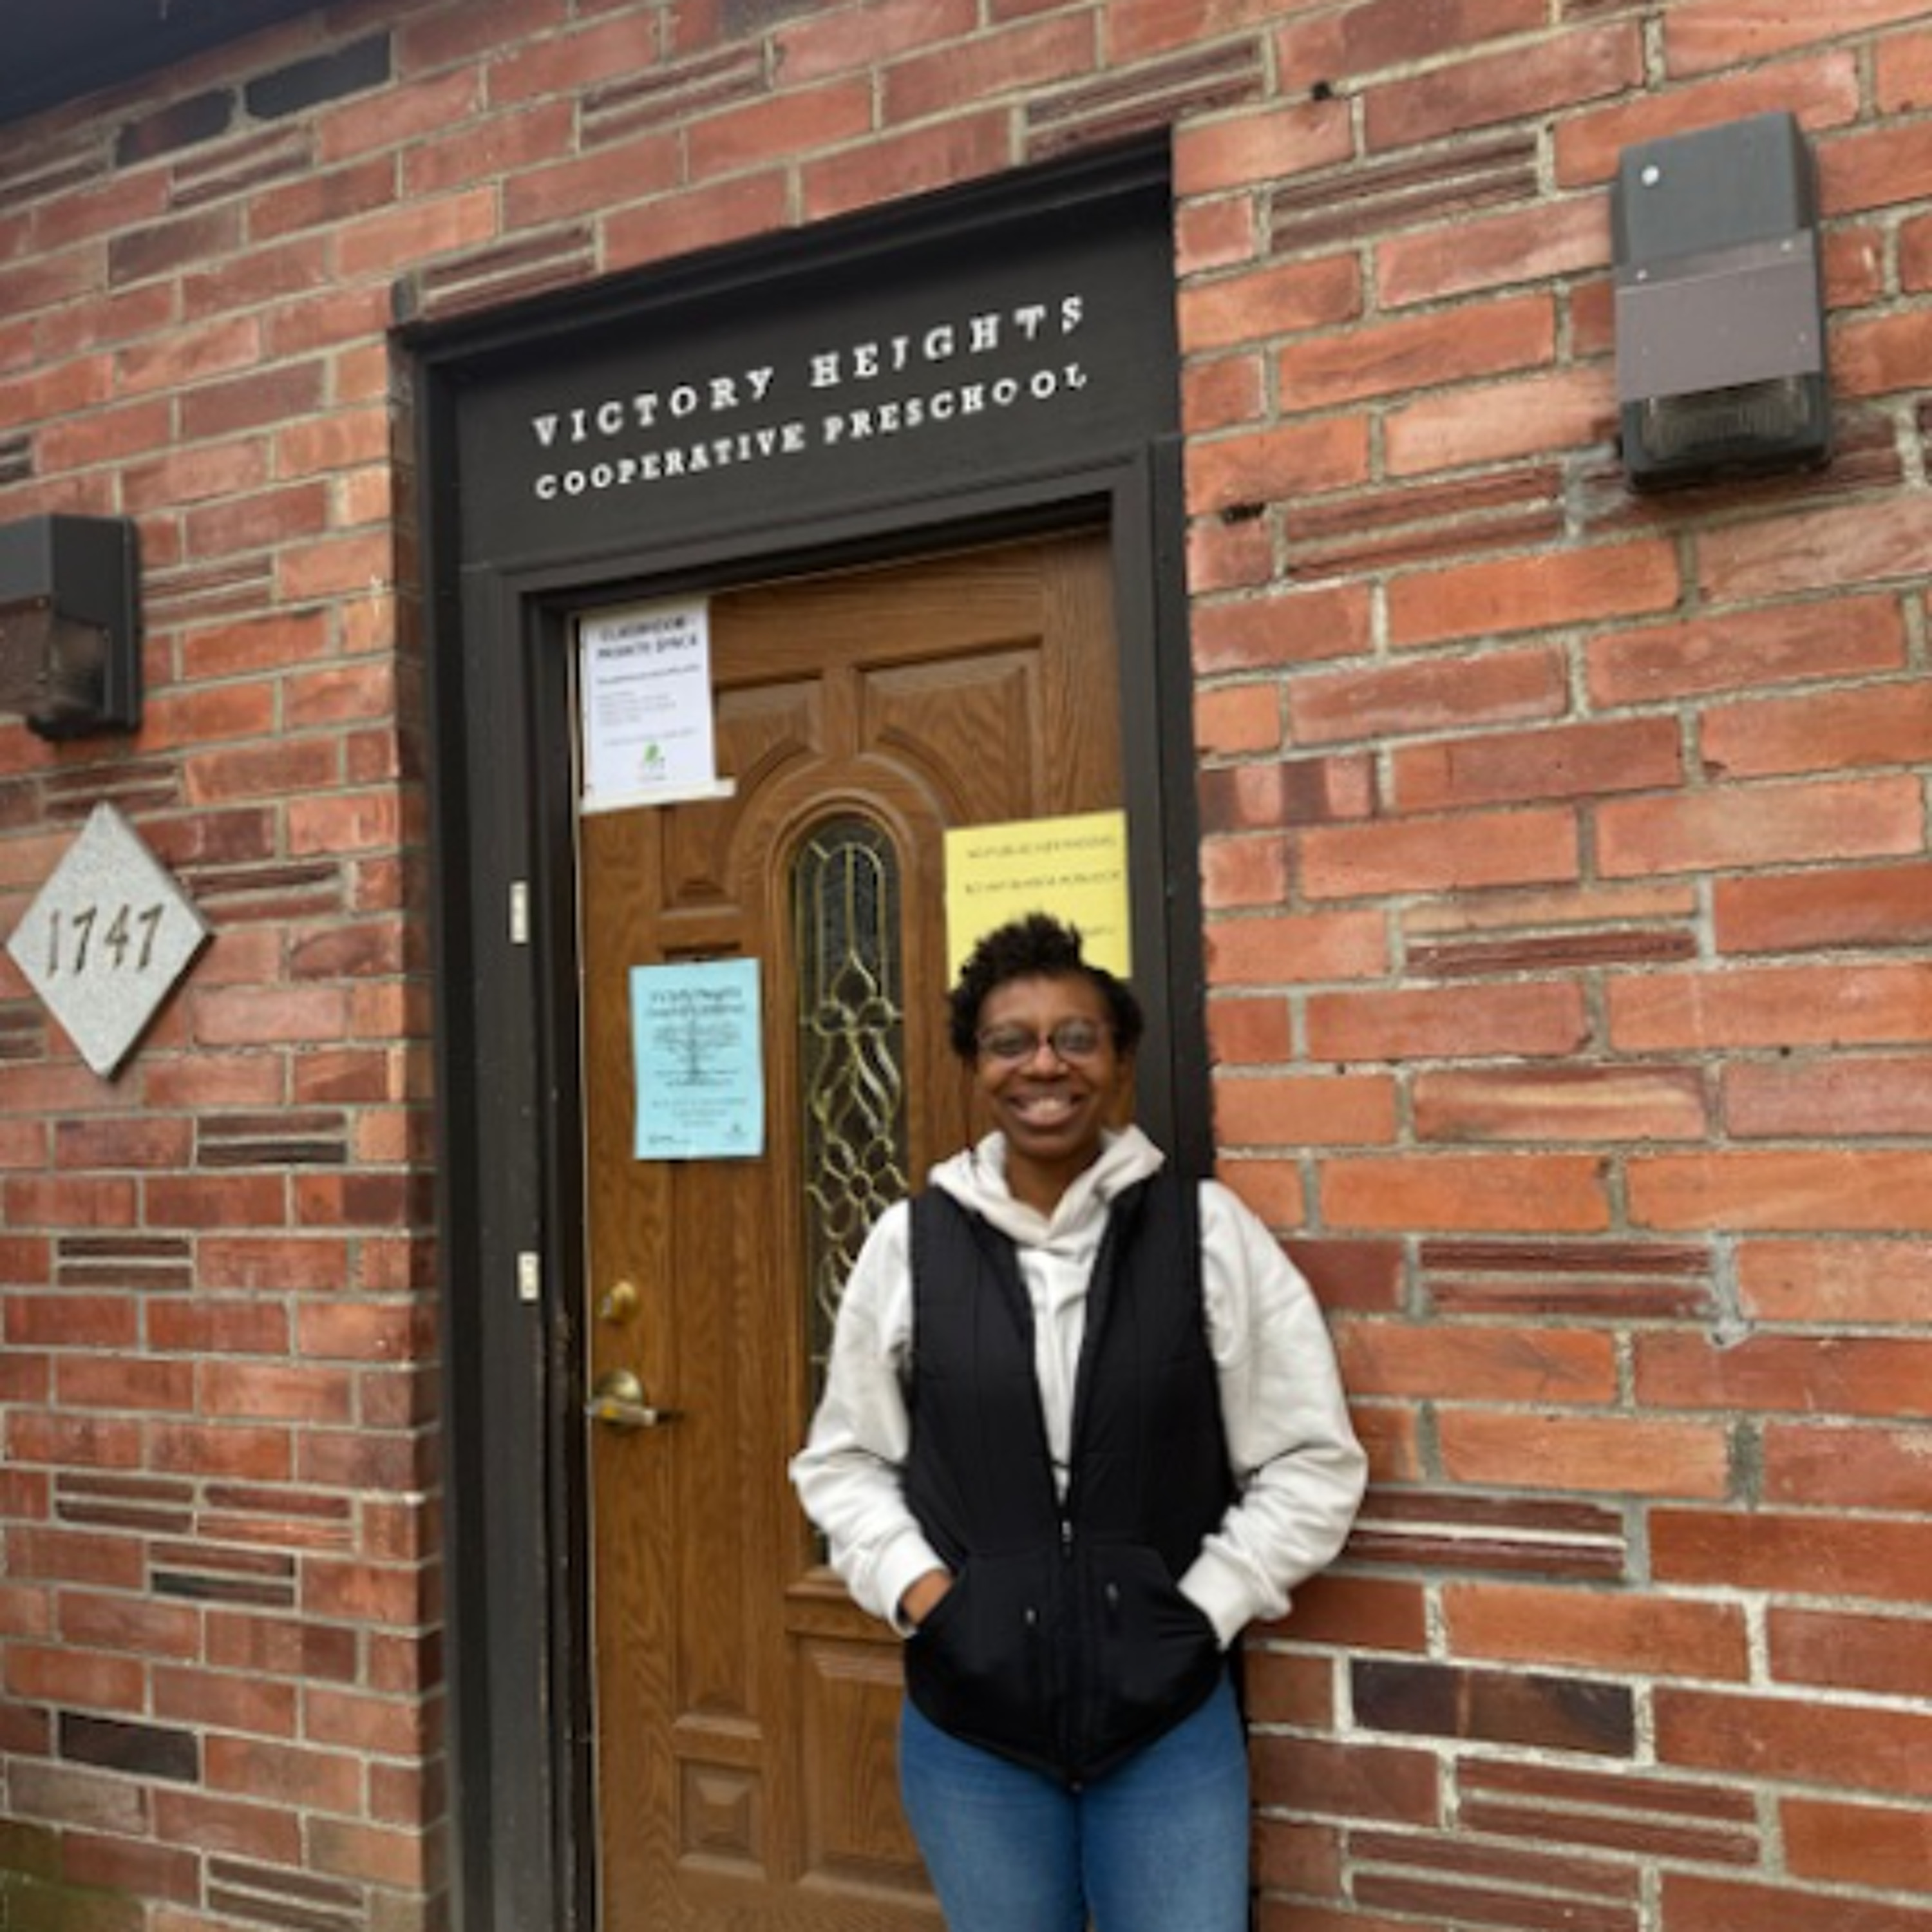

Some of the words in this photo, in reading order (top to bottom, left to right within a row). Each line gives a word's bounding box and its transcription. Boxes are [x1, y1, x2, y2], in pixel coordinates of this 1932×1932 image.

[533, 366, 773, 446] VICTORY
[810, 296, 1083, 388] HEIGHTS
[535, 422, 805, 500] COOPERATIVE
[823, 363, 1087, 444] PRESCHOOL
[48, 904, 164, 978] 1747
